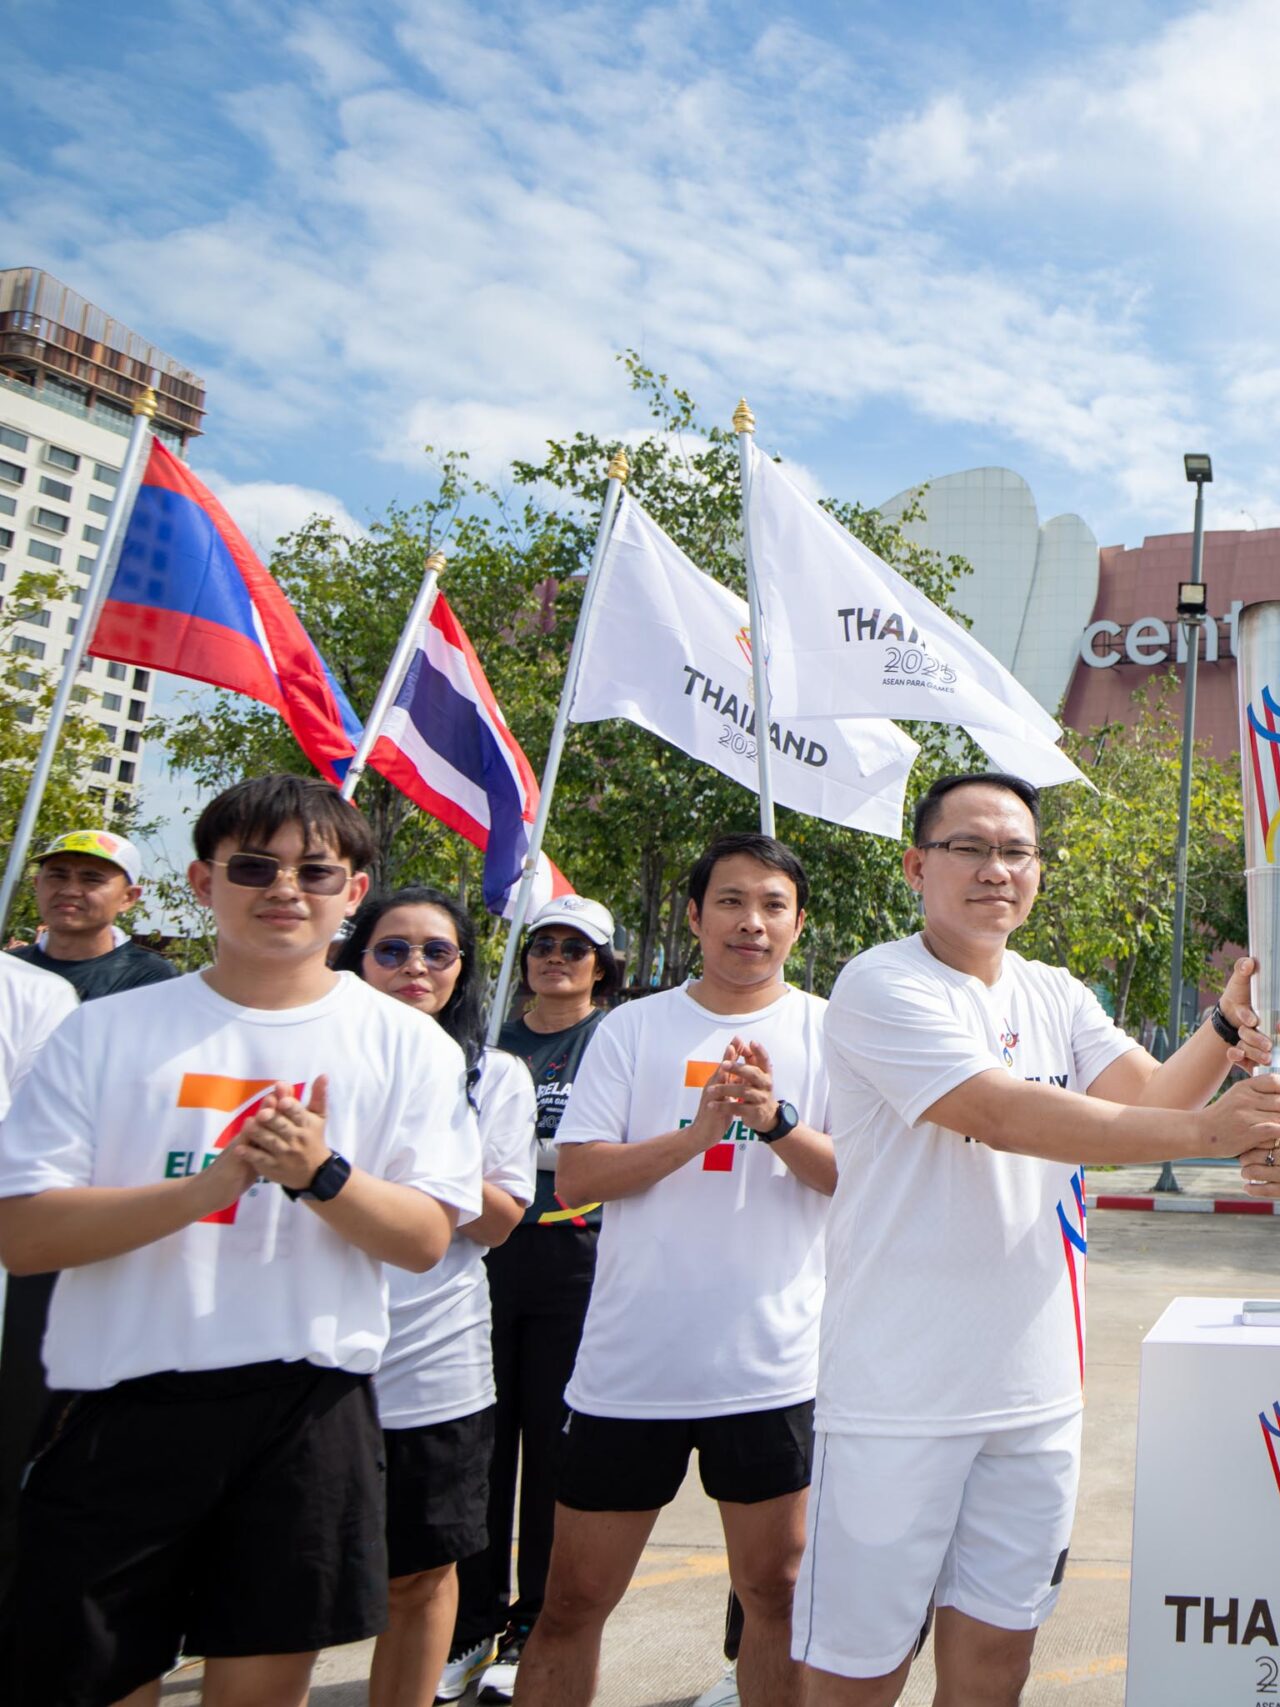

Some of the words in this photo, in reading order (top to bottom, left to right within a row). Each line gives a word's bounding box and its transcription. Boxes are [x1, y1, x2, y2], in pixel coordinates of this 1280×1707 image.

[884, 646, 957, 684] 2025
[882, 678, 905, 686] ASEAN
[906, 679, 925, 687] PARA
[718, 724, 760, 763] 202
[537, 1081, 572, 1098] RELA
